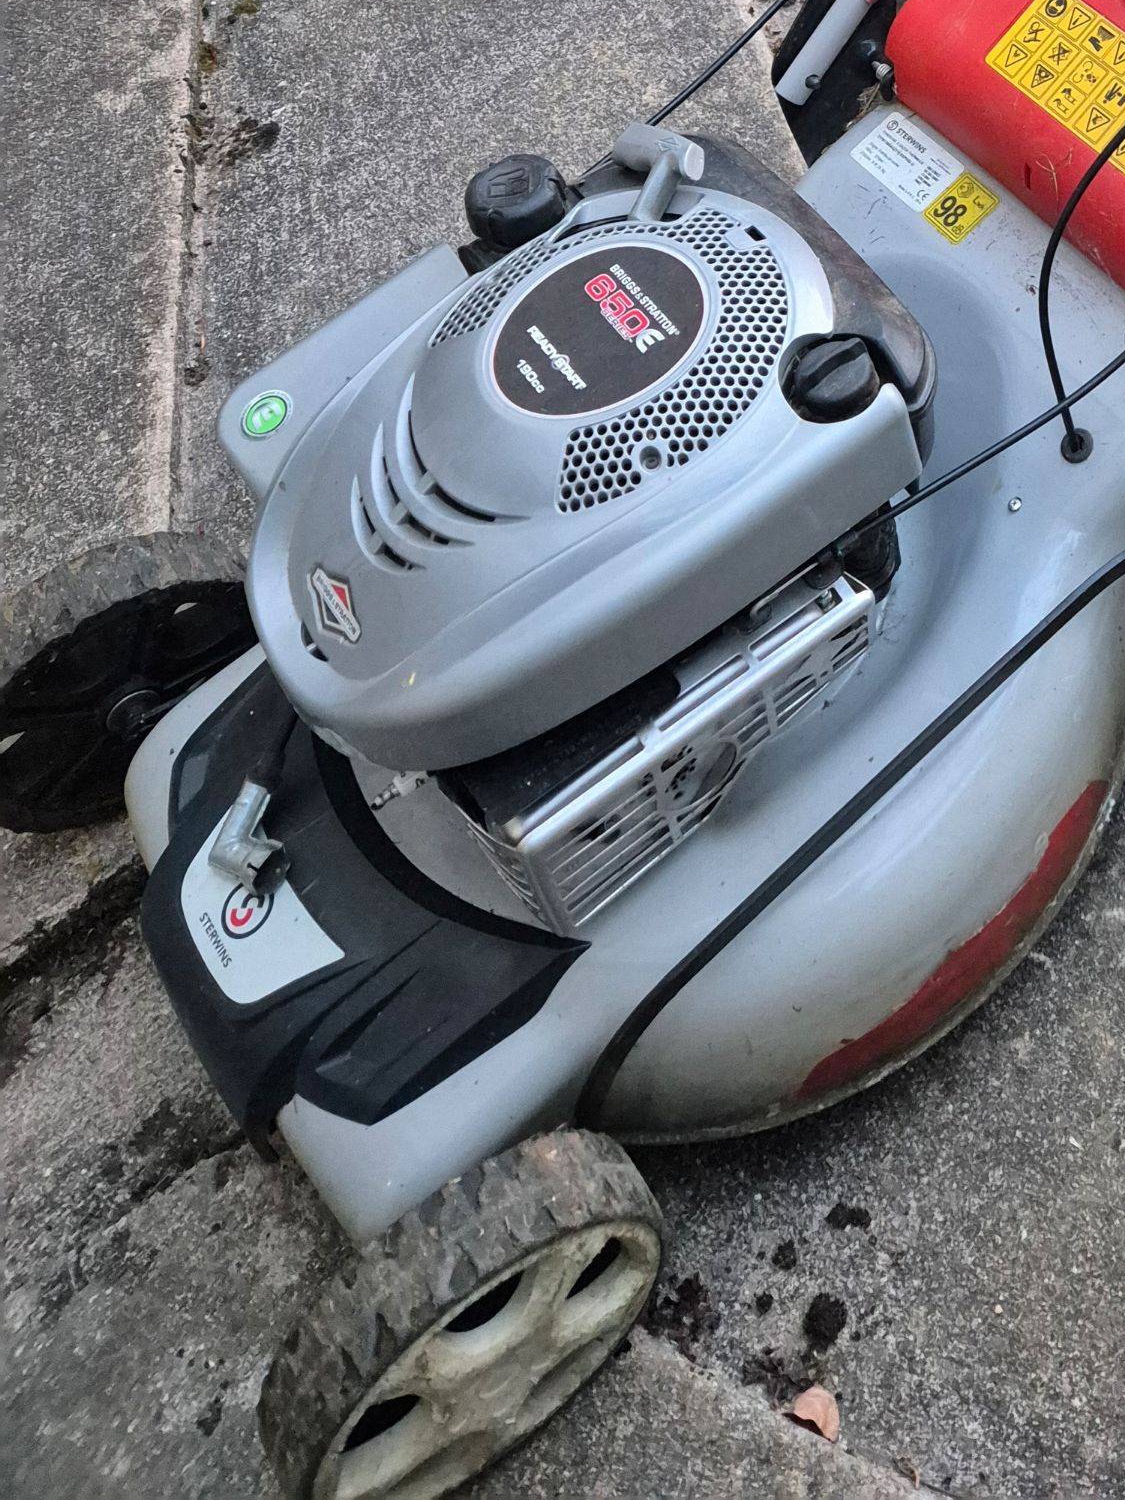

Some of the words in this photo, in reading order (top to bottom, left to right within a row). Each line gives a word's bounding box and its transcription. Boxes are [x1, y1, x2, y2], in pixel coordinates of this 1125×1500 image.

[896, 127, 927, 154] STERWINS
[933, 196, 967, 227] 98
[516, 359, 545, 394] 190cc
[199, 912, 233, 968] STERWINS
